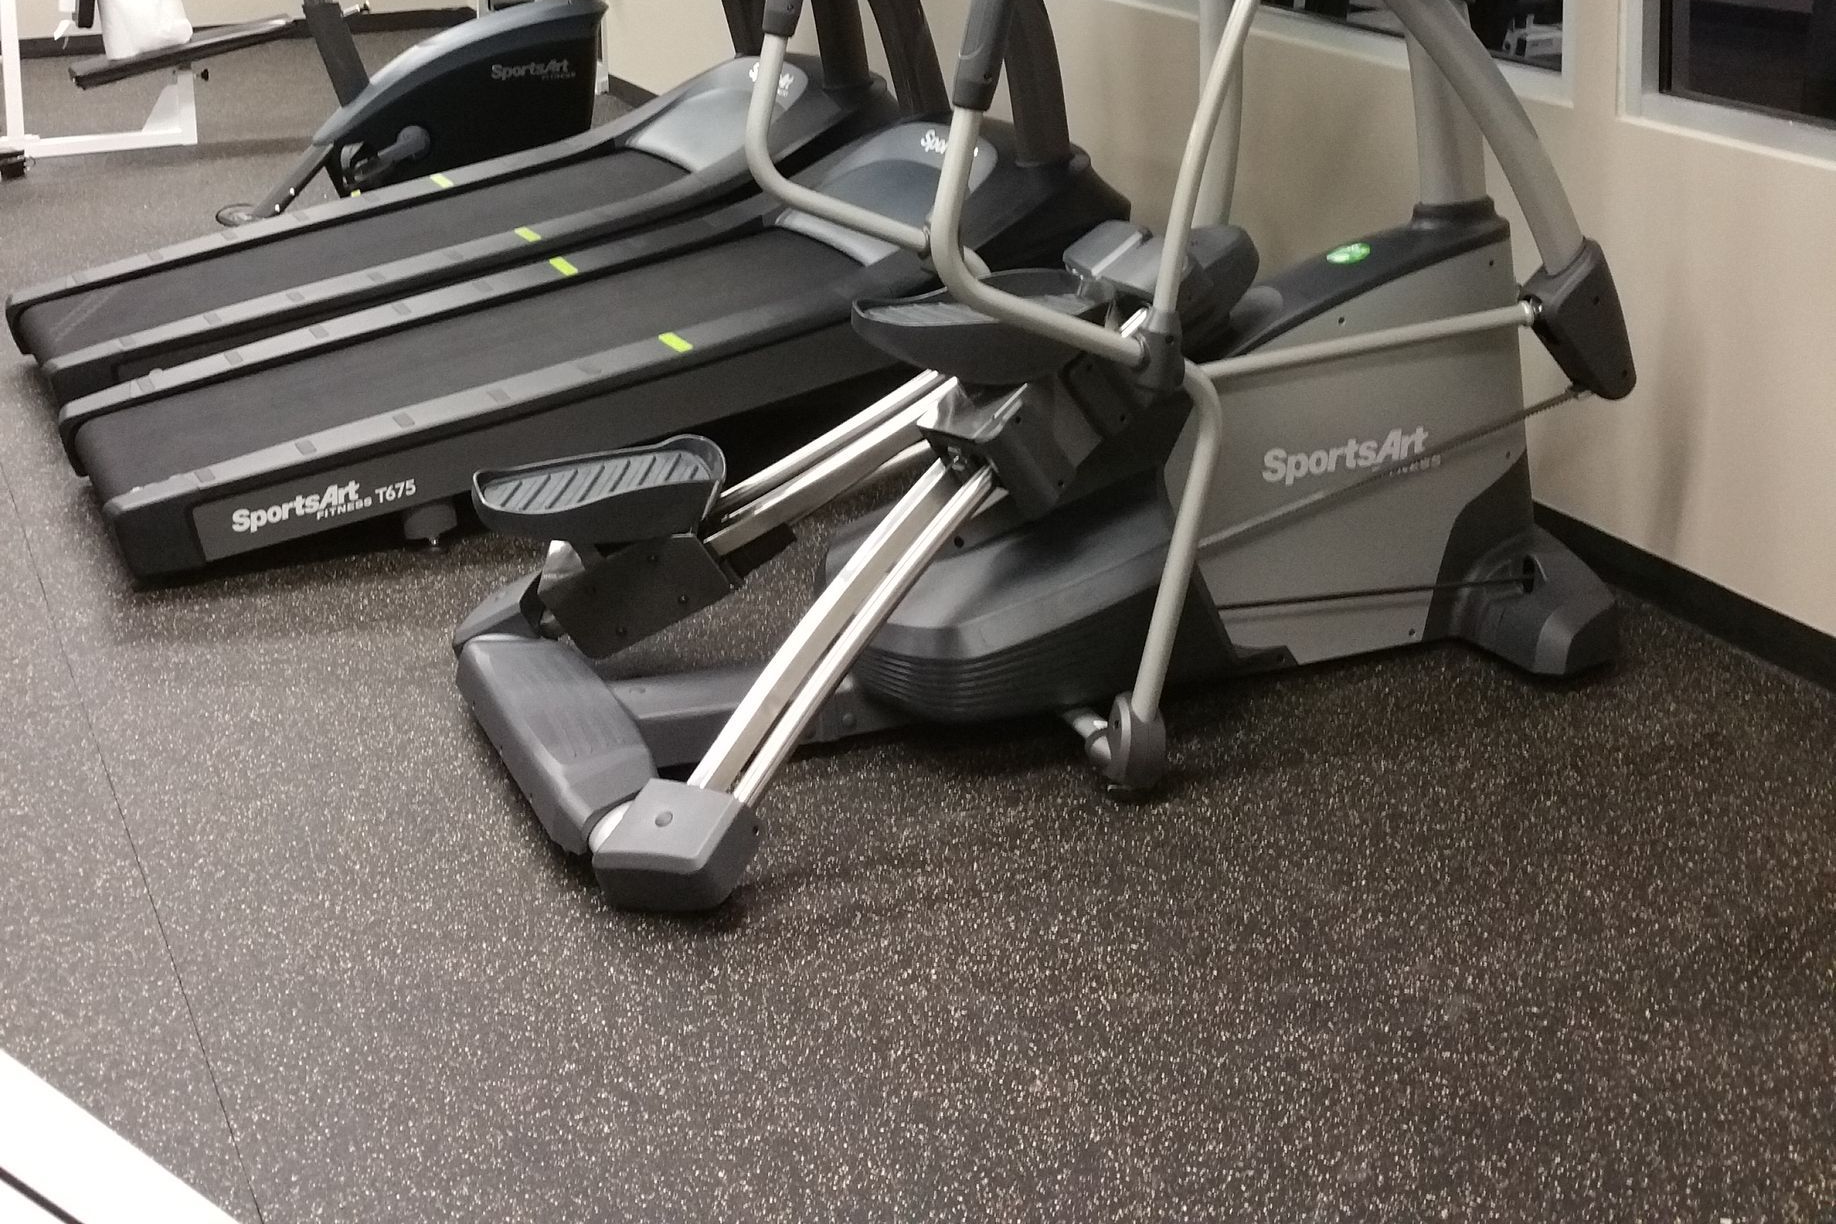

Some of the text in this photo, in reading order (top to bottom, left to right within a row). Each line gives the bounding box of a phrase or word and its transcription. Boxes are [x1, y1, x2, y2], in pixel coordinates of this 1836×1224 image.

[491, 59, 569, 81] SportsArt
[1262, 425, 1429, 486] SportsArt
[232, 480, 360, 533] SportsArt
[316, 478, 416, 521] FITNESS T675
